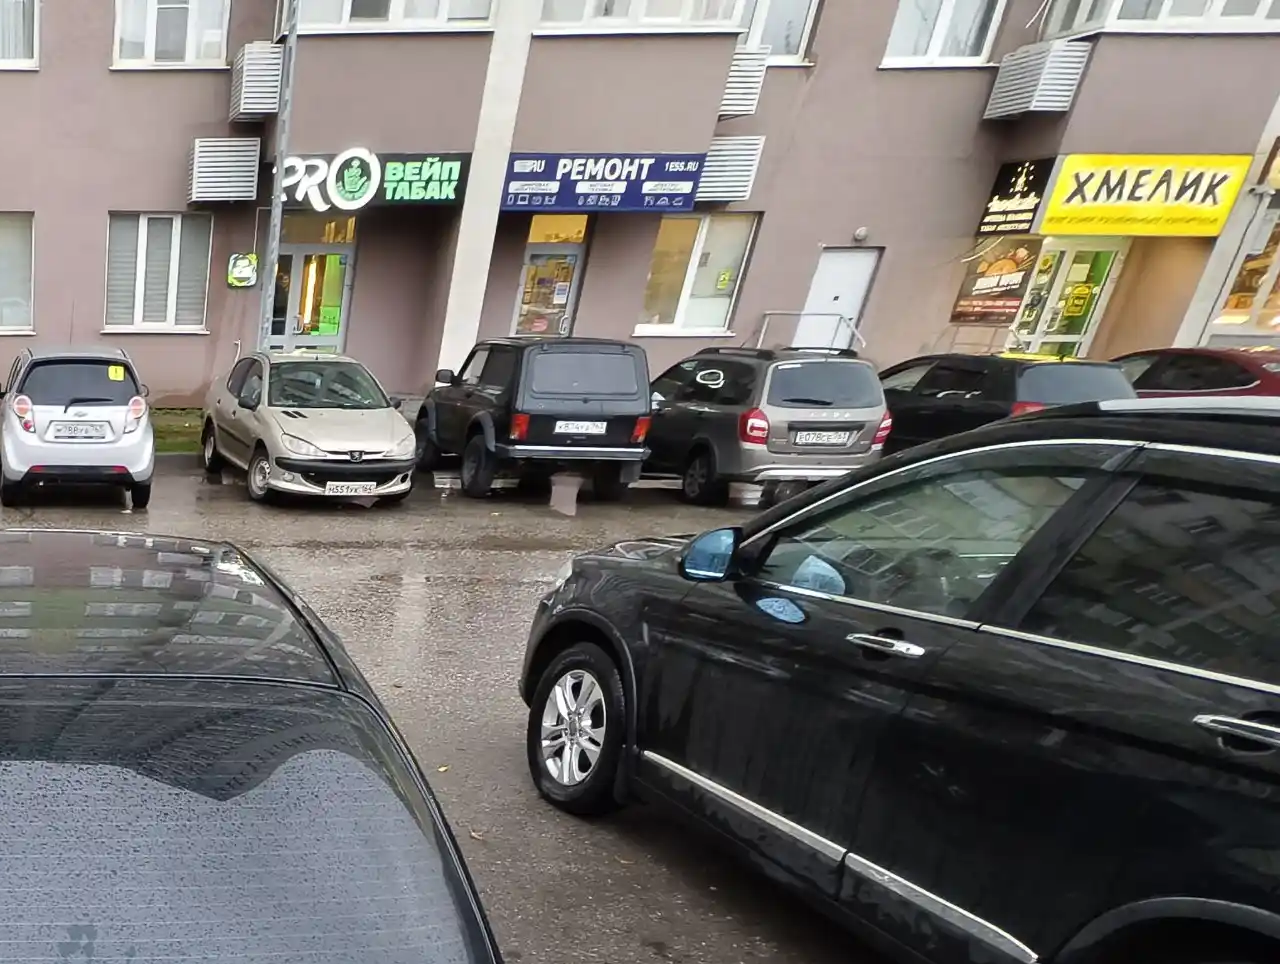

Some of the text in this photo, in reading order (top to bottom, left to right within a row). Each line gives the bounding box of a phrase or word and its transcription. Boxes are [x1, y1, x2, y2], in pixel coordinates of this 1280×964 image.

[385, 157, 462, 181] ВЕЙП
[556, 158, 655, 180] РЕМОНТ
[384, 181, 458, 201] ТАБАК
[1064, 168, 1231, 206] ХМЕЛИК
